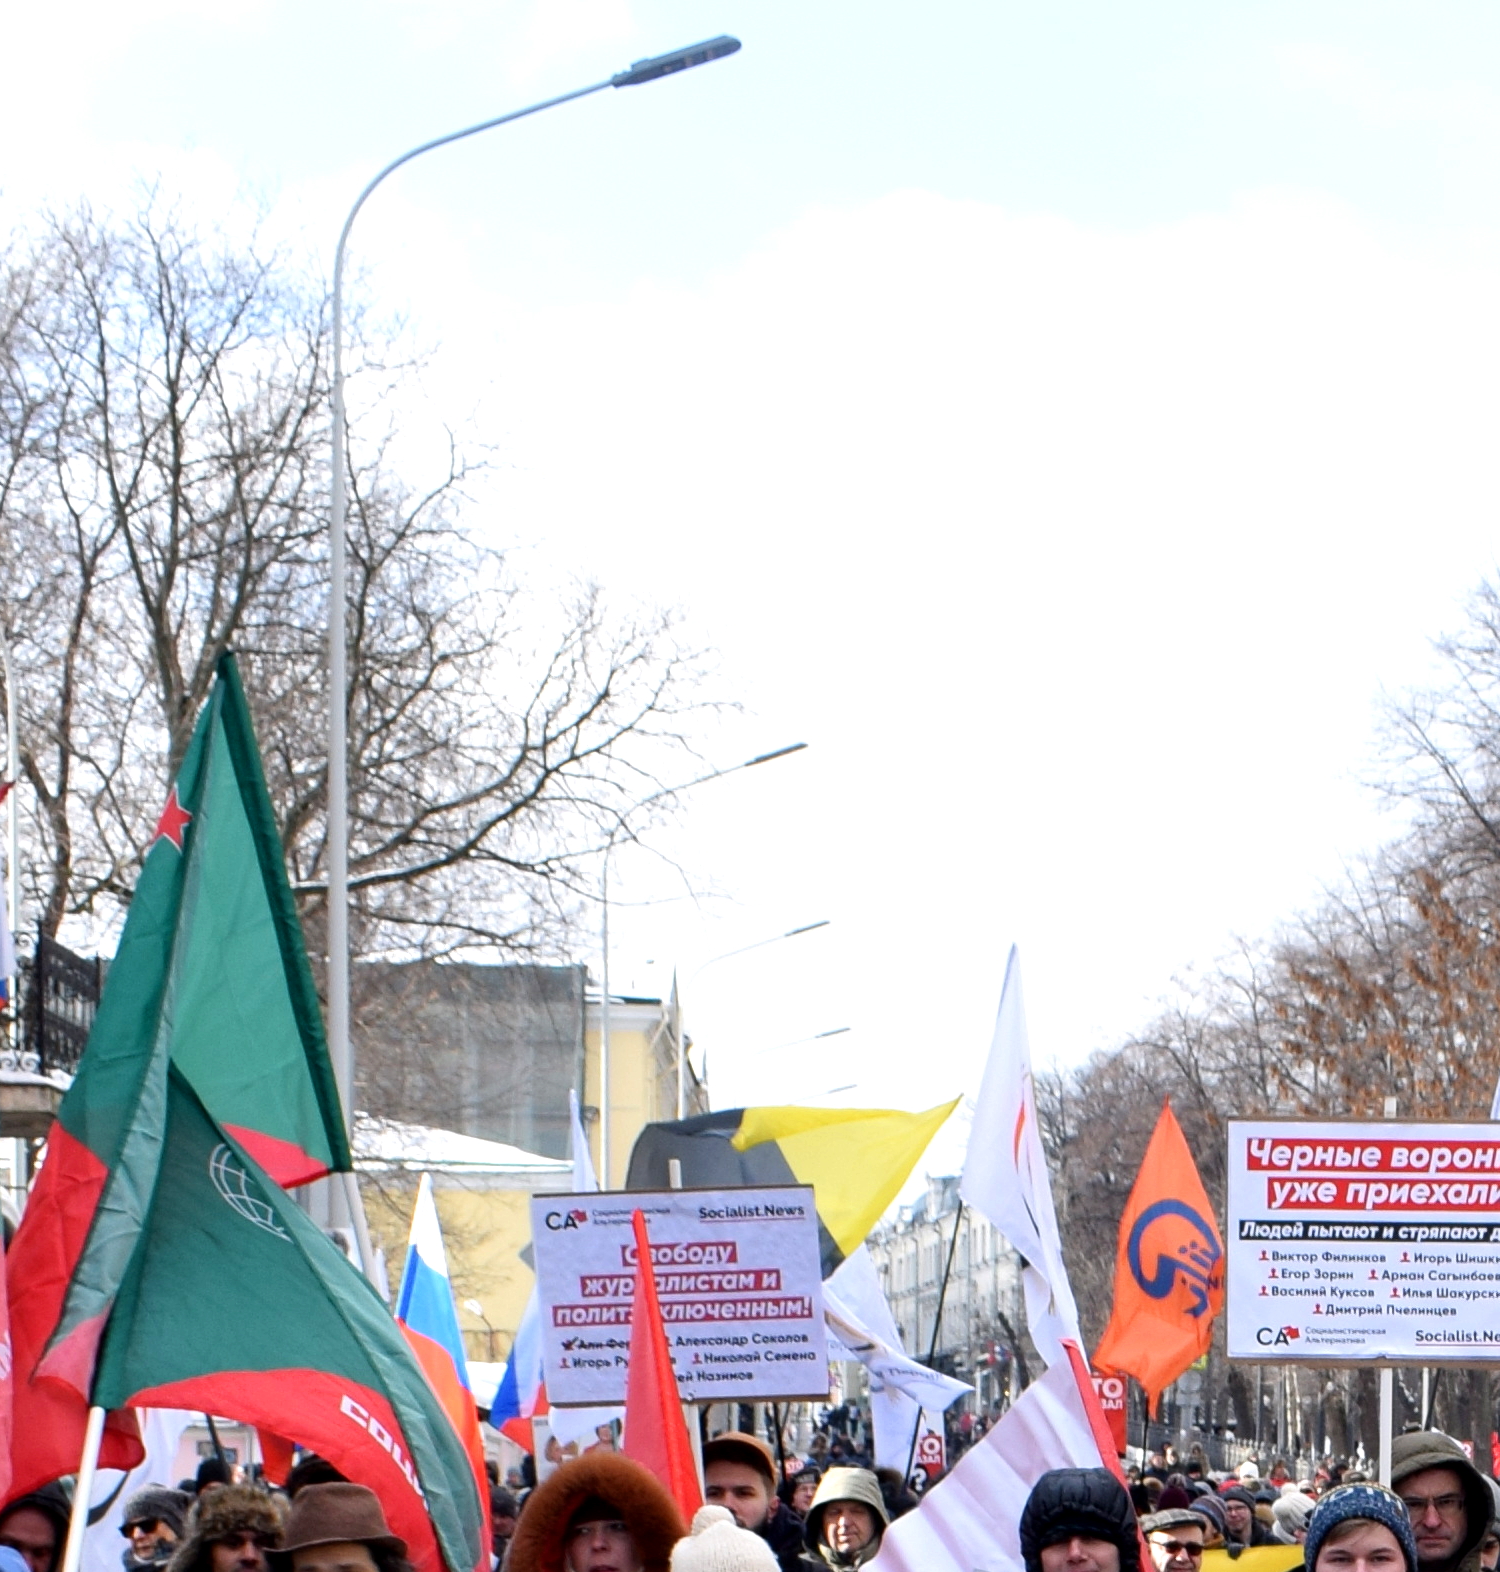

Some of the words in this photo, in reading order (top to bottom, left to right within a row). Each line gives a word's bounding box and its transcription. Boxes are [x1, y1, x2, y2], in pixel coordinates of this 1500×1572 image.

[1249, 1138, 1382, 1173] Черные
[1272, 1180, 1338, 1209] уже
[699, 1205, 805, 1219] Socialist.News
[1241, 1221, 1303, 1240] Людей
[1308, 1224, 1379, 1239] пытают
[1382, 1227, 1394, 1239] и
[1398, 1226, 1487, 1241] стряпают
[1272, 1252, 1318, 1264] Виктор
[1321, 1252, 1387, 1263] Филинков
[1414, 1253, 1452, 1266] Игорь
[1281, 1269, 1310, 1280] Егор
[1314, 1269, 1354, 1280] Зорин
[1382, 1270, 1424, 1282] Арман
[584, 1272, 755, 1296] журалистам
[763, 1272, 777, 1287] и
[1272, 1286, 1327, 1297] Василий
[1330, 1287, 1375, 1299] Куксов
[1402, 1288, 1433, 1298] Илья
[556, 1297, 812, 1324] политключенным!
[1326, 1304, 1382, 1317] Дмитрий
[1387, 1305, 1457, 1317] Пчелинцев
[676, 1335, 748, 1348] Александр
[752, 1333, 809, 1345] Соколов
[573, 1357, 611, 1369] Игорь
[704, 1352, 761, 1365] Николай
[765, 1351, 816, 1362] Семена
[697, 1371, 754, 1382] Назимов
